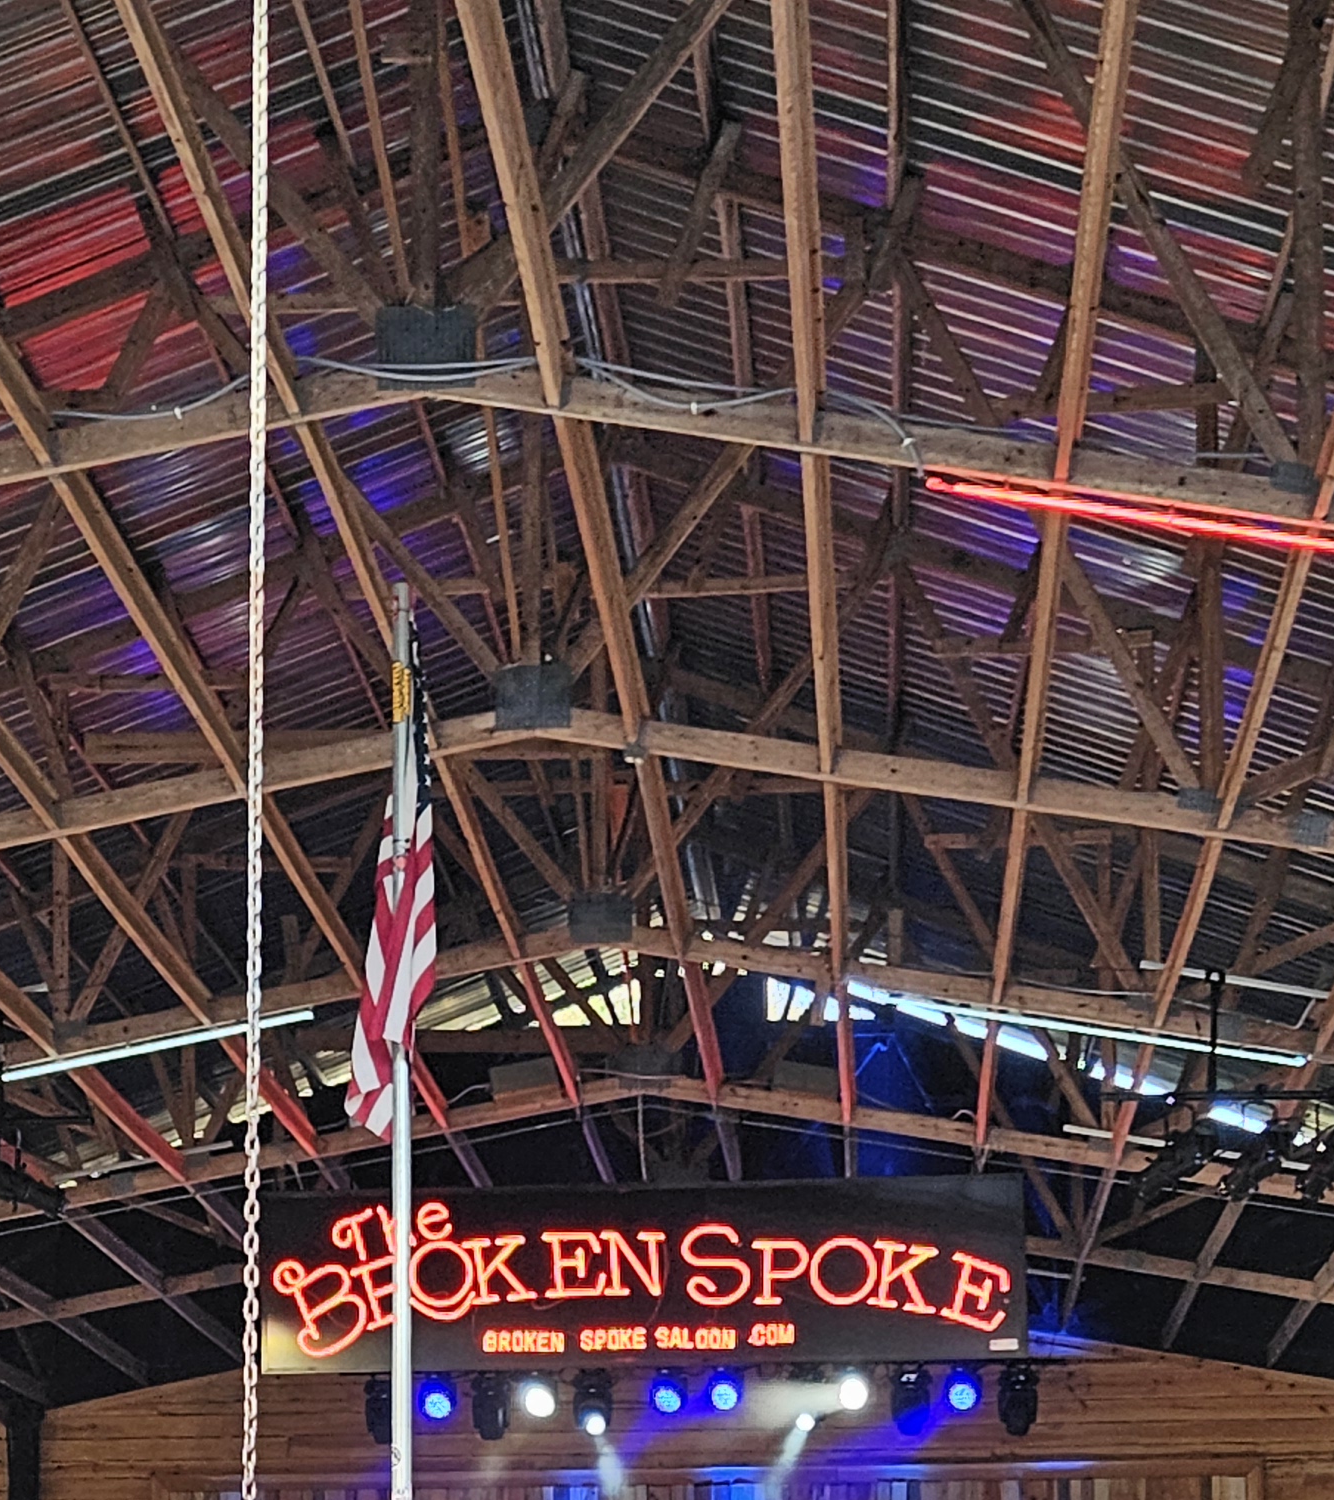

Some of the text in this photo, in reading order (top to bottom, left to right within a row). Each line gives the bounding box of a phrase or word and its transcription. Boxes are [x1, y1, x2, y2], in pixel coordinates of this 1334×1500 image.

[679, 1223, 1012, 1334] SPOKE
[482, 1328, 566, 1354] BROKEN
[579, 1326, 648, 1352] SPOKE
[655, 1326, 737, 1351] SALOON
